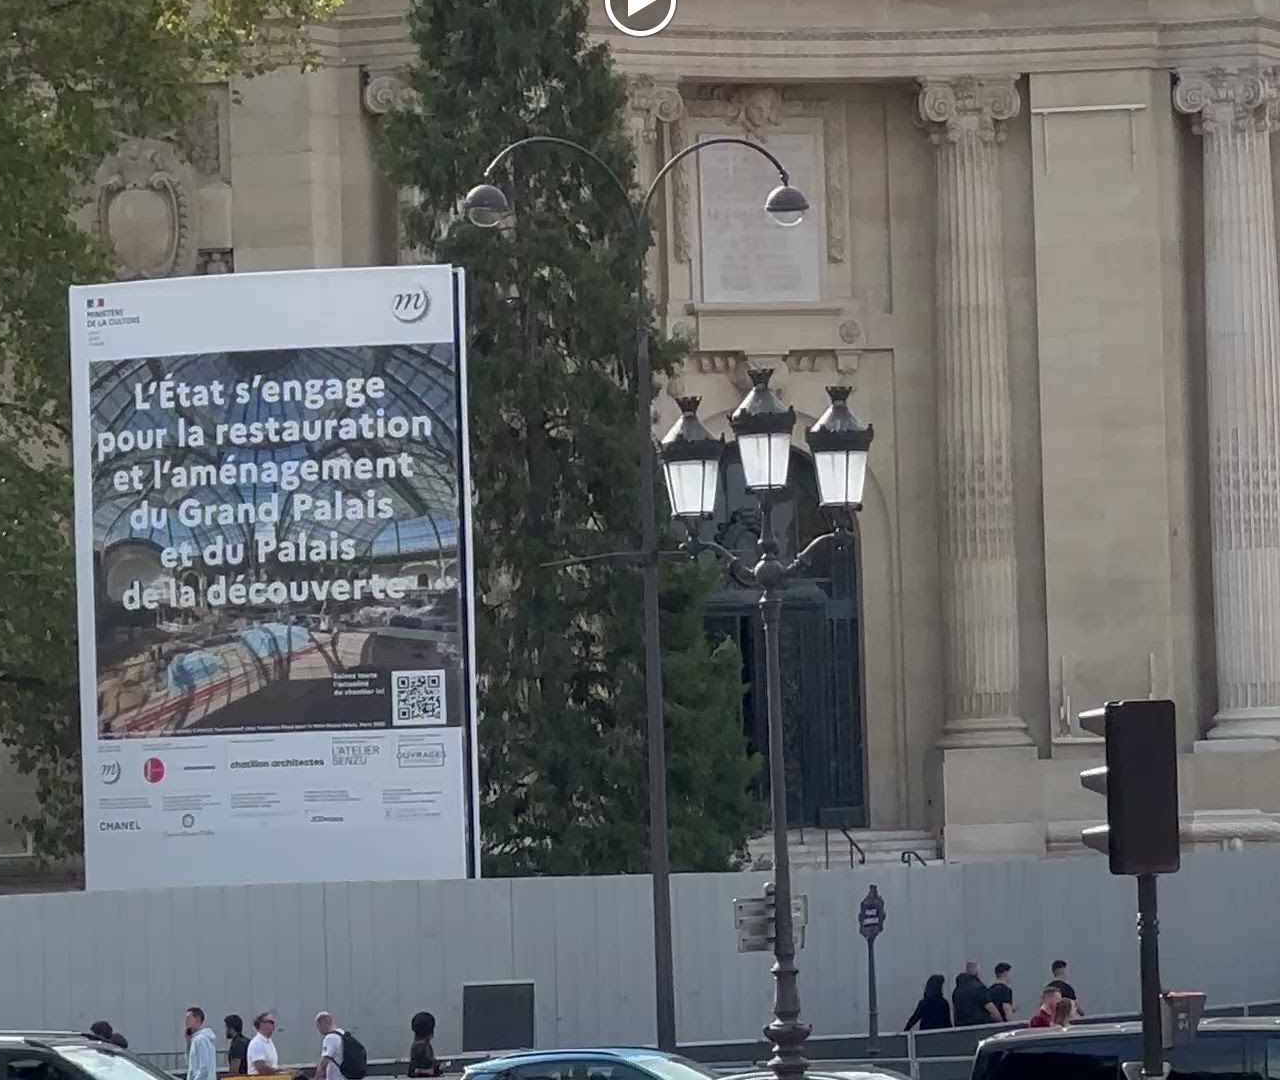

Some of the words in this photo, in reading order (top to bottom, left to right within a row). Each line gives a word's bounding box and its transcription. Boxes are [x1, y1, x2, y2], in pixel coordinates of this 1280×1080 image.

[134, 373, 225, 410] L'État
[235, 374, 386, 410] s'engage
[97, 427, 168, 462] pour
[177, 417, 205, 448] la
[215, 407, 433, 446] restauration
[112, 464, 144, 491] et
[153, 452, 415, 491] l'aménagement
[129, 500, 168, 531] du
[177, 491, 280, 528] Grand
[292, 488, 394, 521] Palais
[159, 540, 193, 568] et
[202, 535, 244, 566] du
[256, 531, 356, 563] Palais
[121, 580, 159, 610] de
[169, 577, 196, 609] la
[206, 574, 407, 606] découverte
[271, 758, 325, 768] architectes
[99, 820, 142, 832] CHANEL
